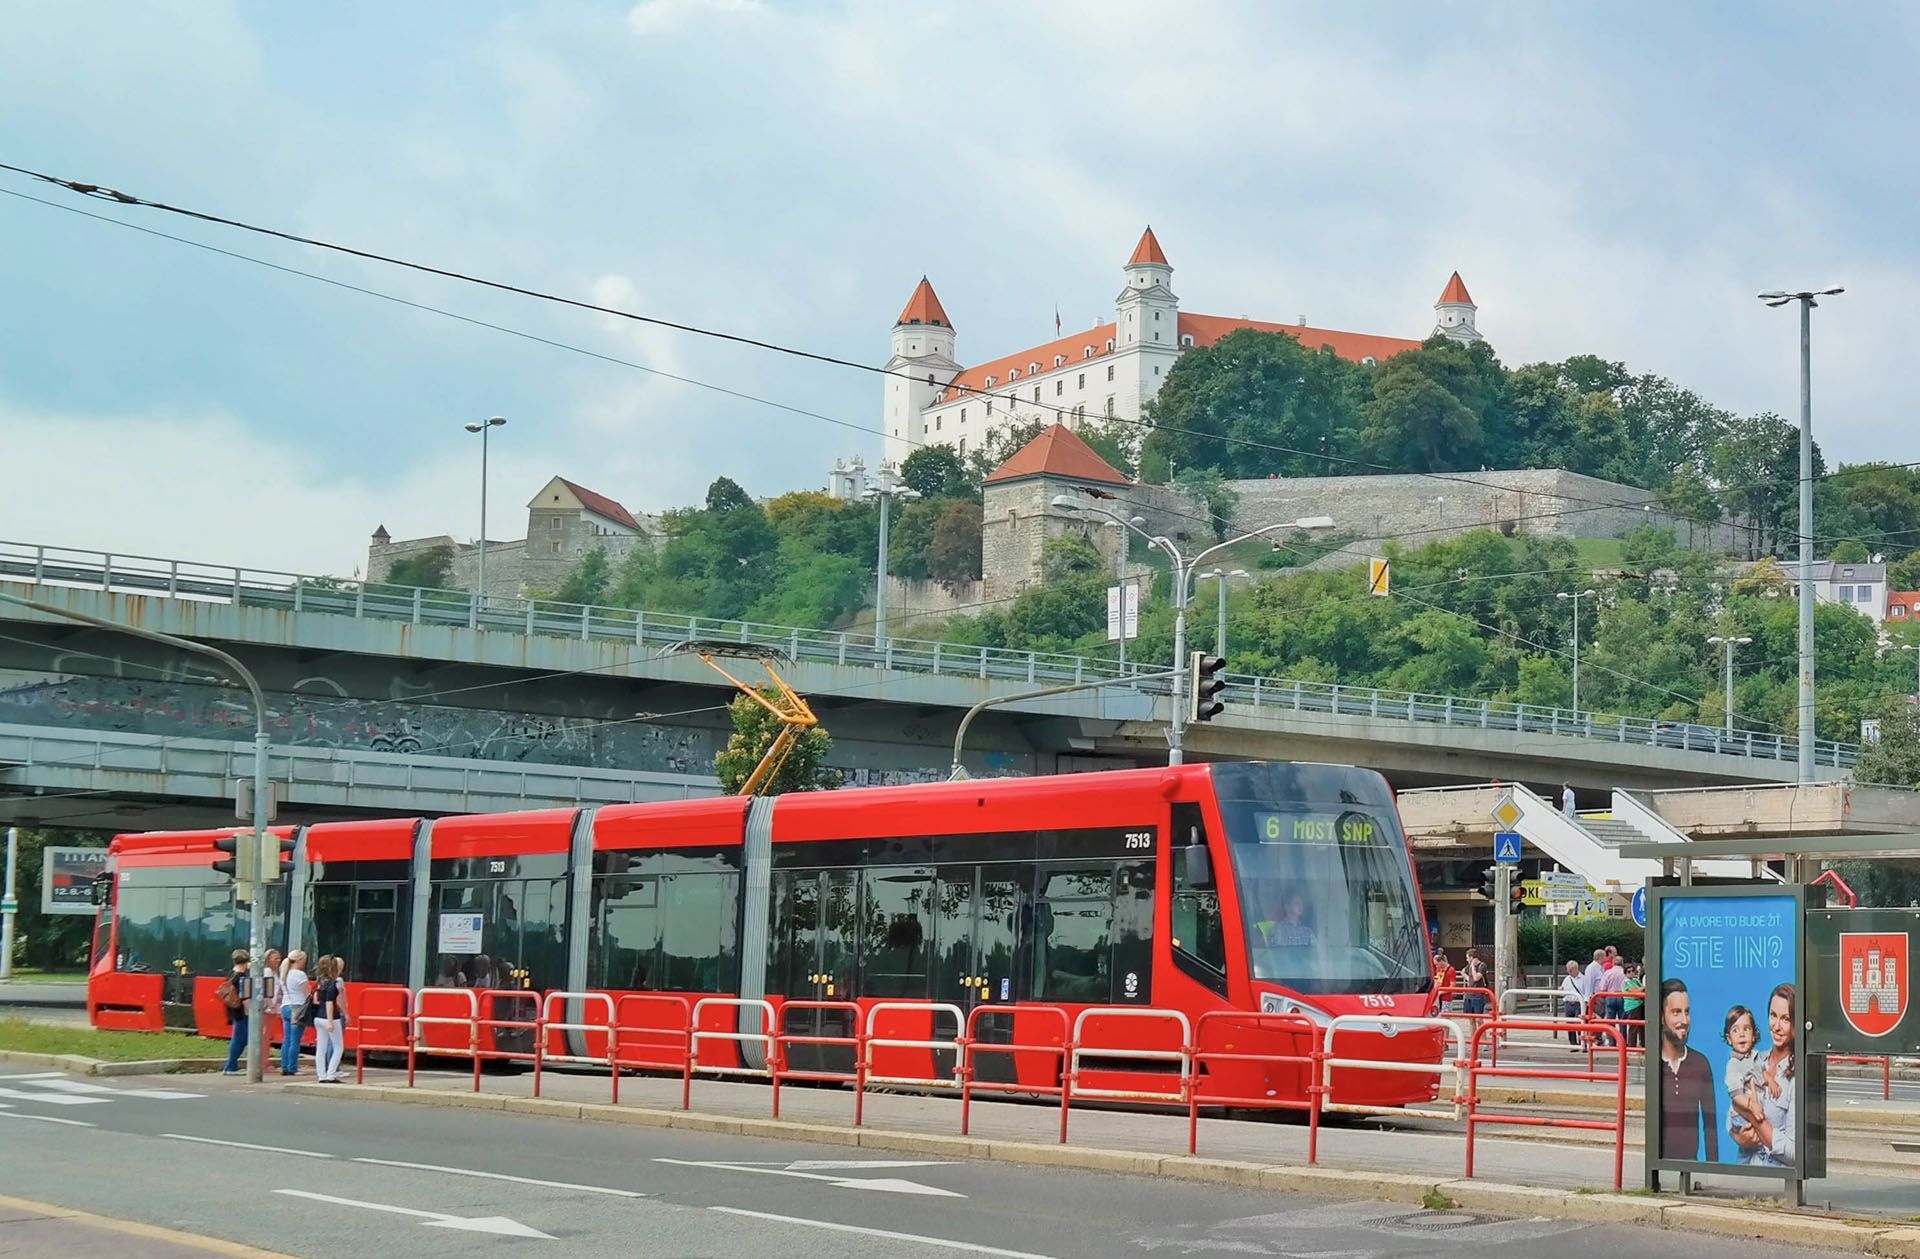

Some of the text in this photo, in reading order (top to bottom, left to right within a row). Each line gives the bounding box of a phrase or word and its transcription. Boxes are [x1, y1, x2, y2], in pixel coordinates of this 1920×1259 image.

[1266, 817, 1373, 842] 6 MOST SNP
[1125, 832, 1151, 849] 7513
[64, 853, 108, 862] TITAN
[490, 861, 505, 873] 7513
[1675, 915, 1689, 928] NA
[1725, 915, 1737, 928] TO
[1738, 915, 1766, 928] BUDE
[1674, 935, 1724, 969] STE
[1359, 994, 1396, 1008] 7513
